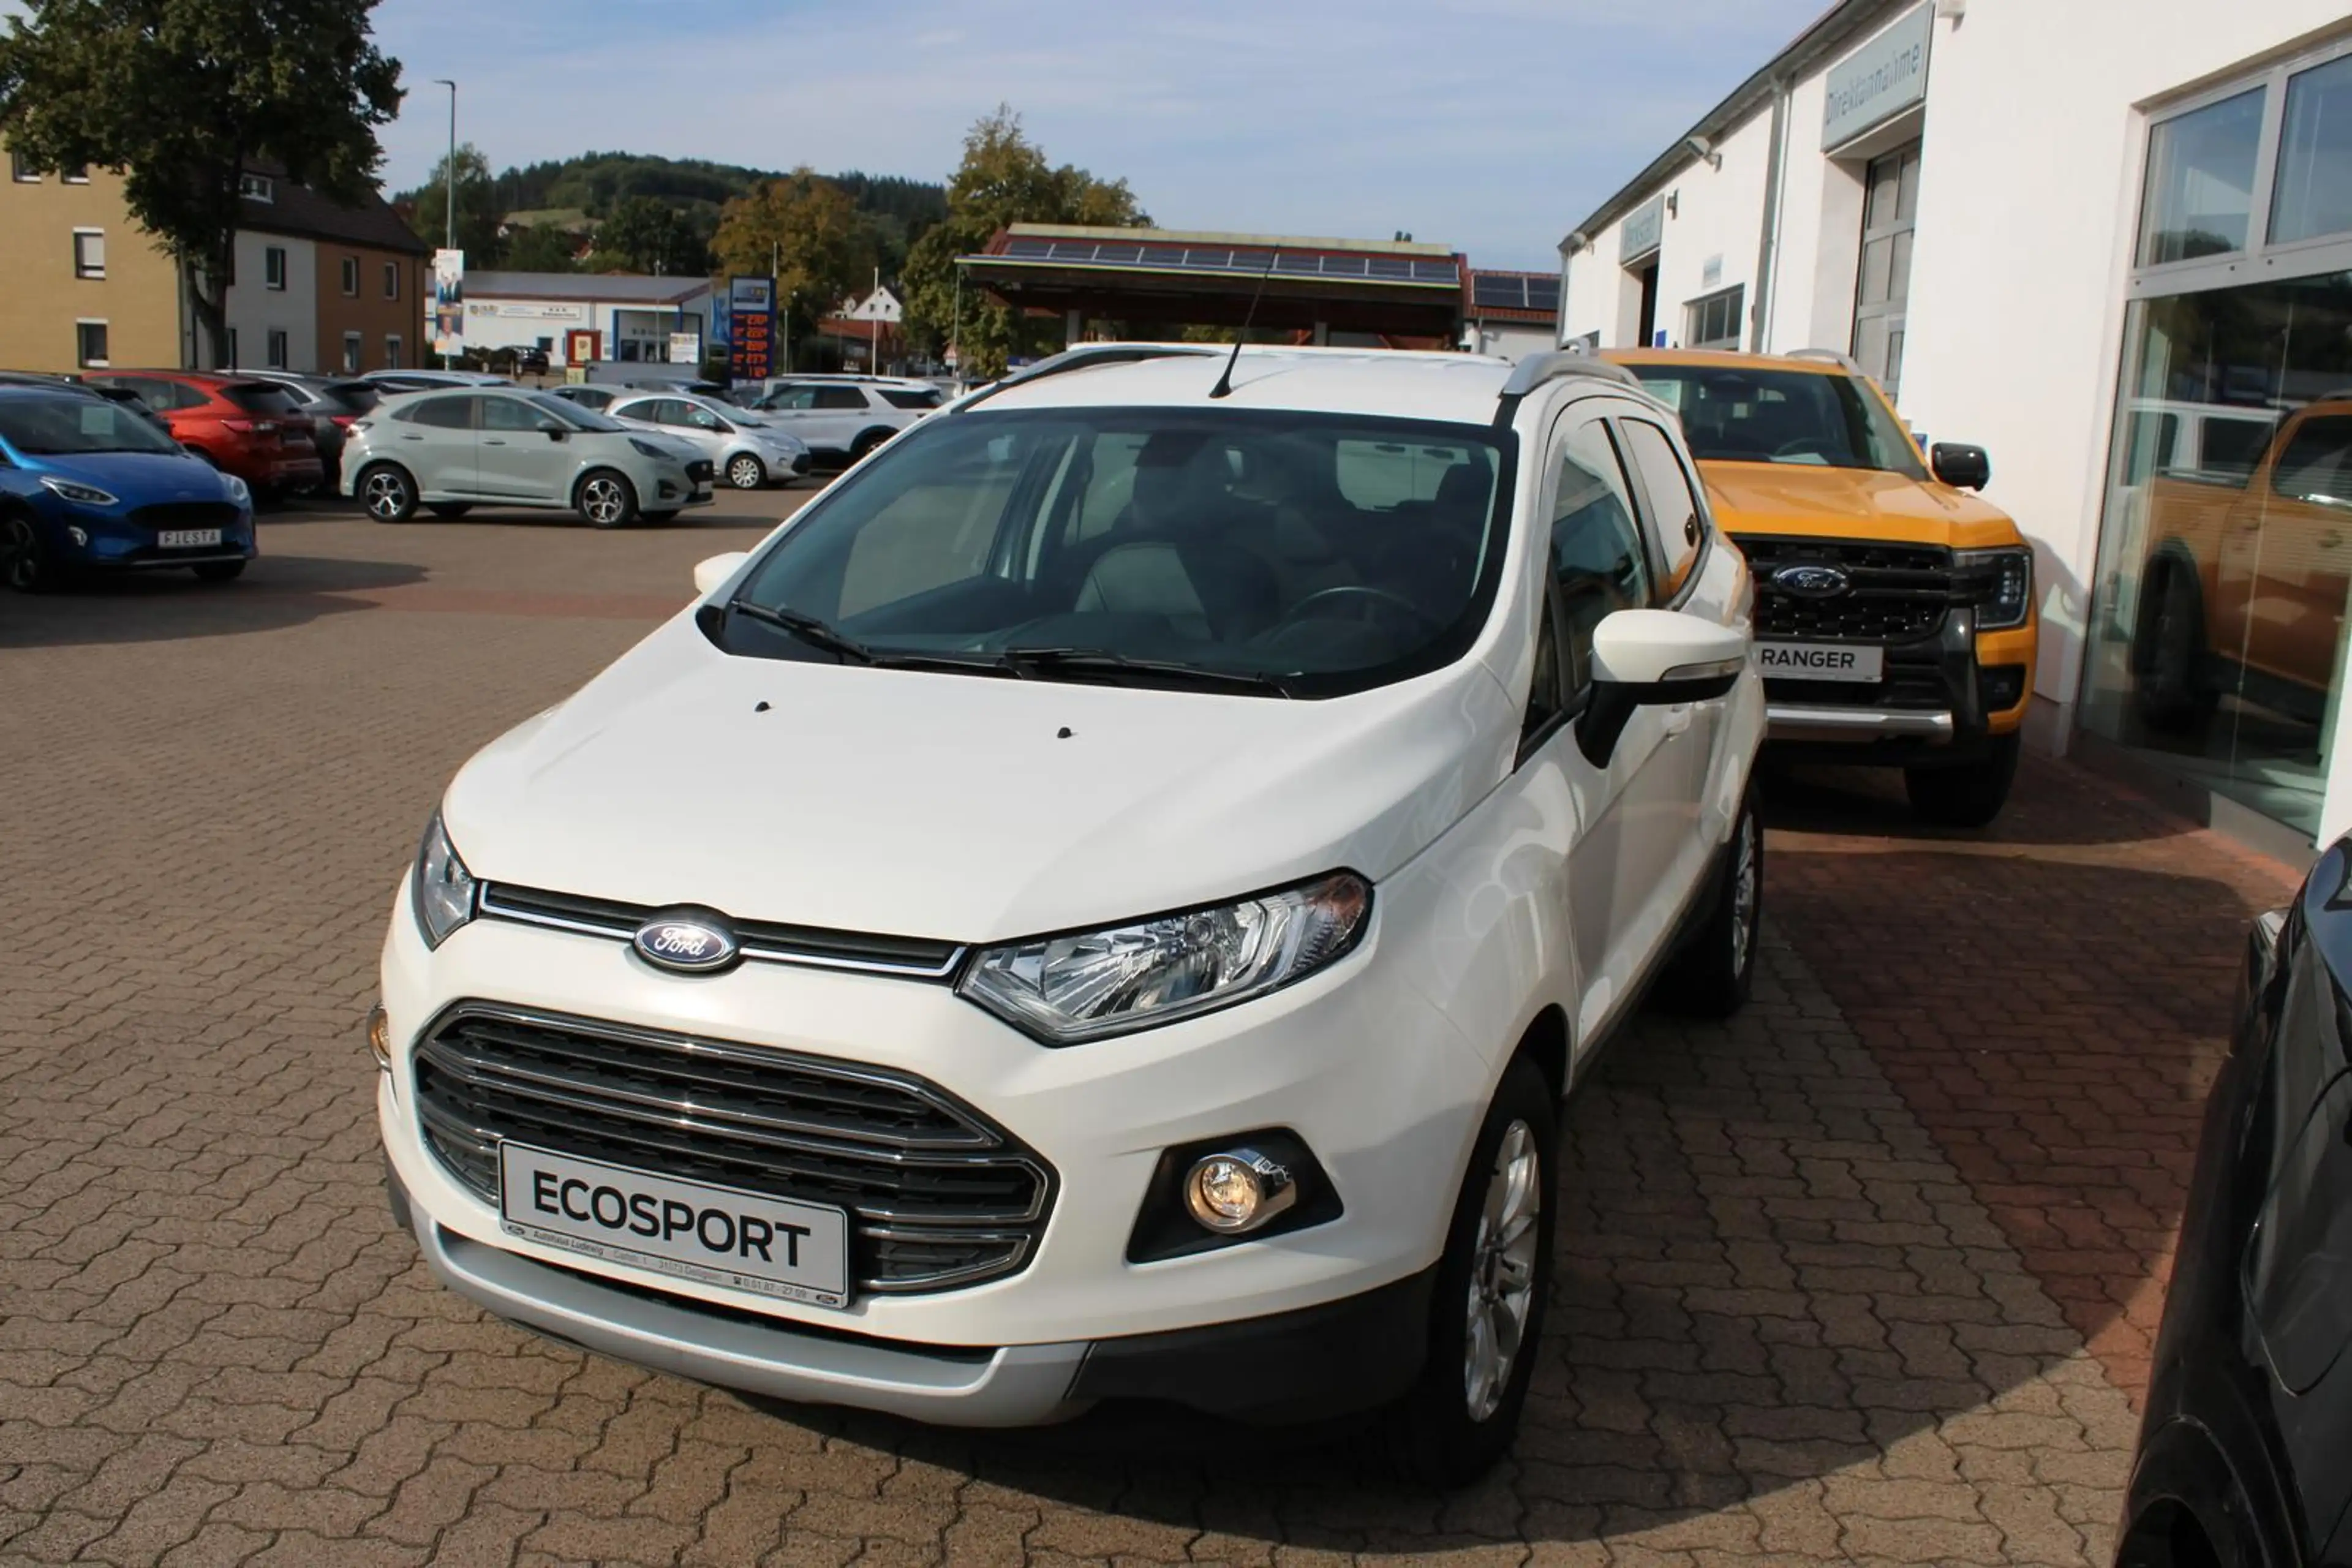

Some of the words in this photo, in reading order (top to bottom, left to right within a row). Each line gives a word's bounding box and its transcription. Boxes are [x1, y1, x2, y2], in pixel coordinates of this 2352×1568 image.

[164, 529, 216, 545] FIESTA
[1761, 648, 1856, 669] RANGER
[654, 927, 709, 957] Ford
[533, 1169, 811, 1267] ECOSPORT
